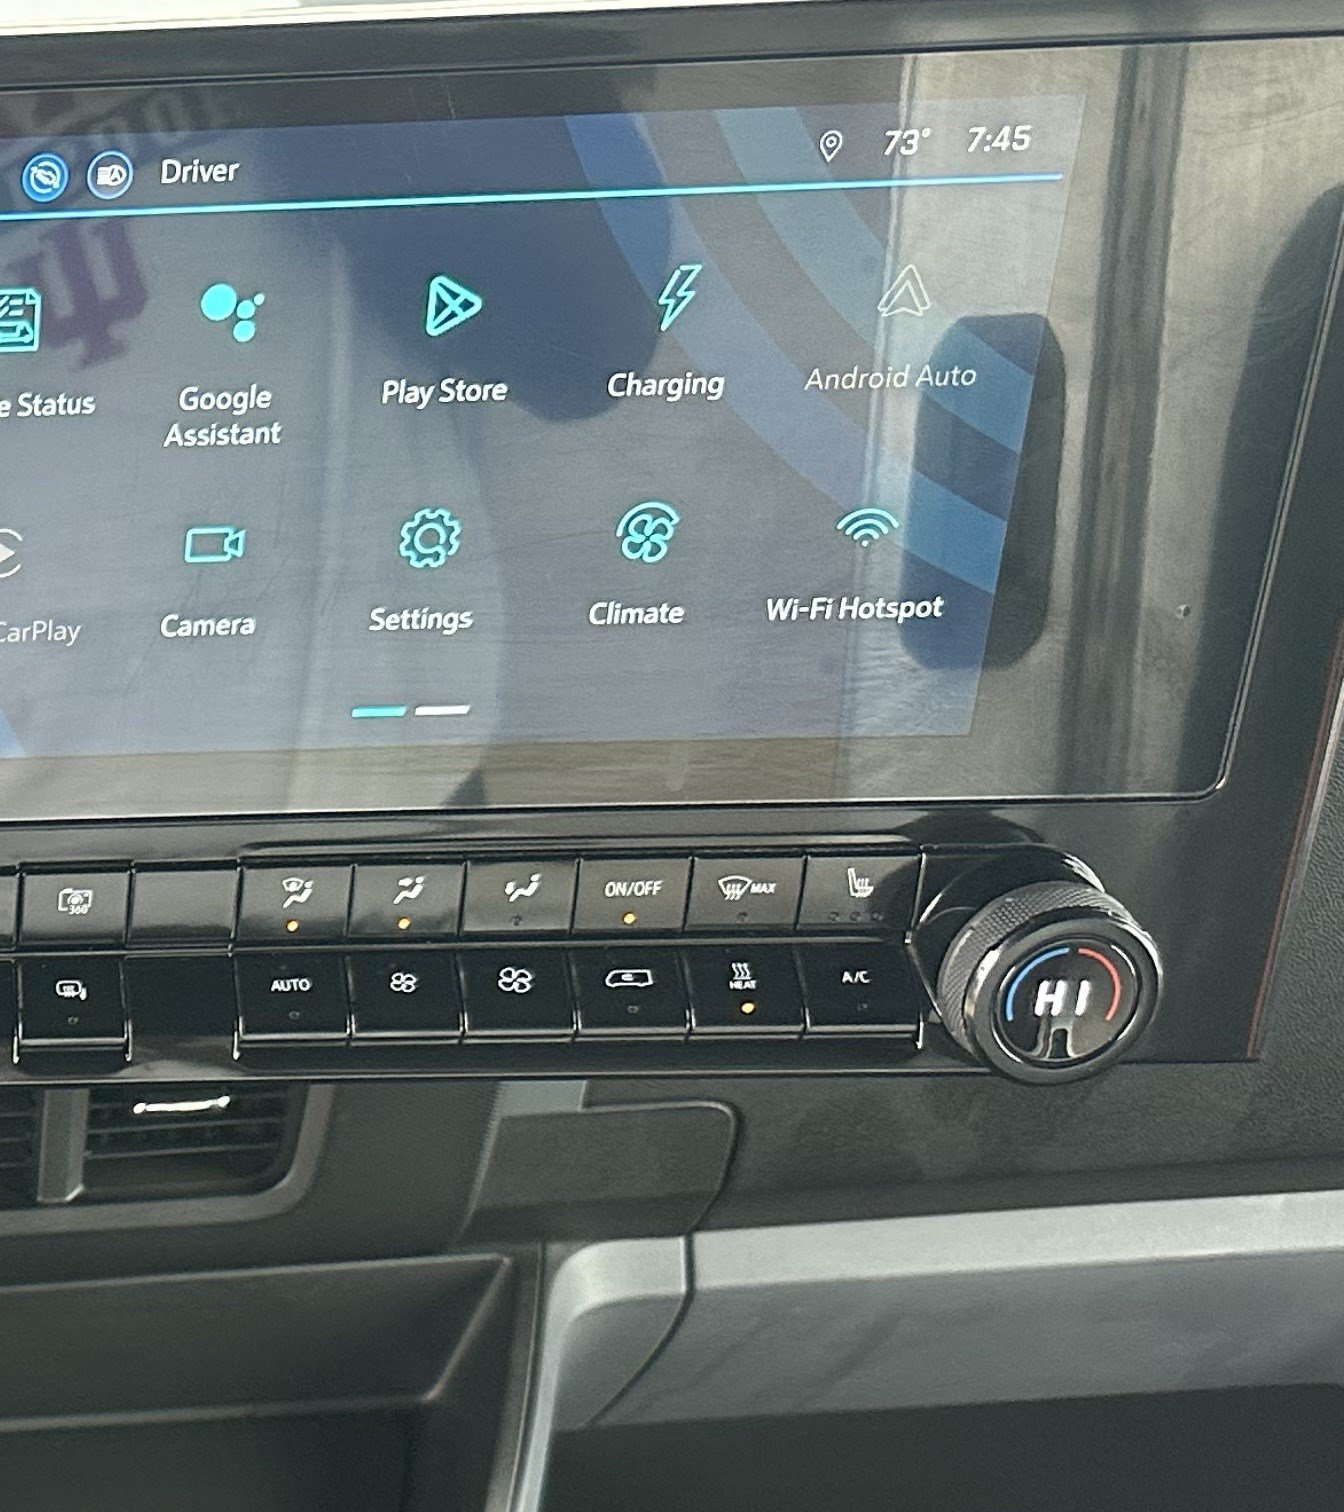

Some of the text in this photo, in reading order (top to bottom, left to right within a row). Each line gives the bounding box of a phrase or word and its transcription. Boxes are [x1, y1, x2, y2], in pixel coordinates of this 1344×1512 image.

[883, 127, 932, 156] 73°
[967, 124, 1033, 153] 7:45
[162, 159, 241, 185] Driver
[608, 372, 726, 404] Charging
[804, 364, 977, 391] Android Auto
[17, 393, 97, 418] Status
[180, 384, 274, 417] Google
[381, 377, 509, 410] Play Store
[164, 423, 283, 448] Assistant
[369, 607, 475, 636] Settings
[590, 602, 686, 626] Climate
[766, 595, 945, 624] Wi-Fi Hotspot
[161, 614, 257, 639] Camera
[605, 881, 663, 898] ON/OFF
[748, 881, 779, 895] MAX
[68, 903, 89, 915] 360
[271, 979, 312, 993] AUTO
[728, 979, 758, 991] HEAT
[843, 971, 871, 985] A/C
